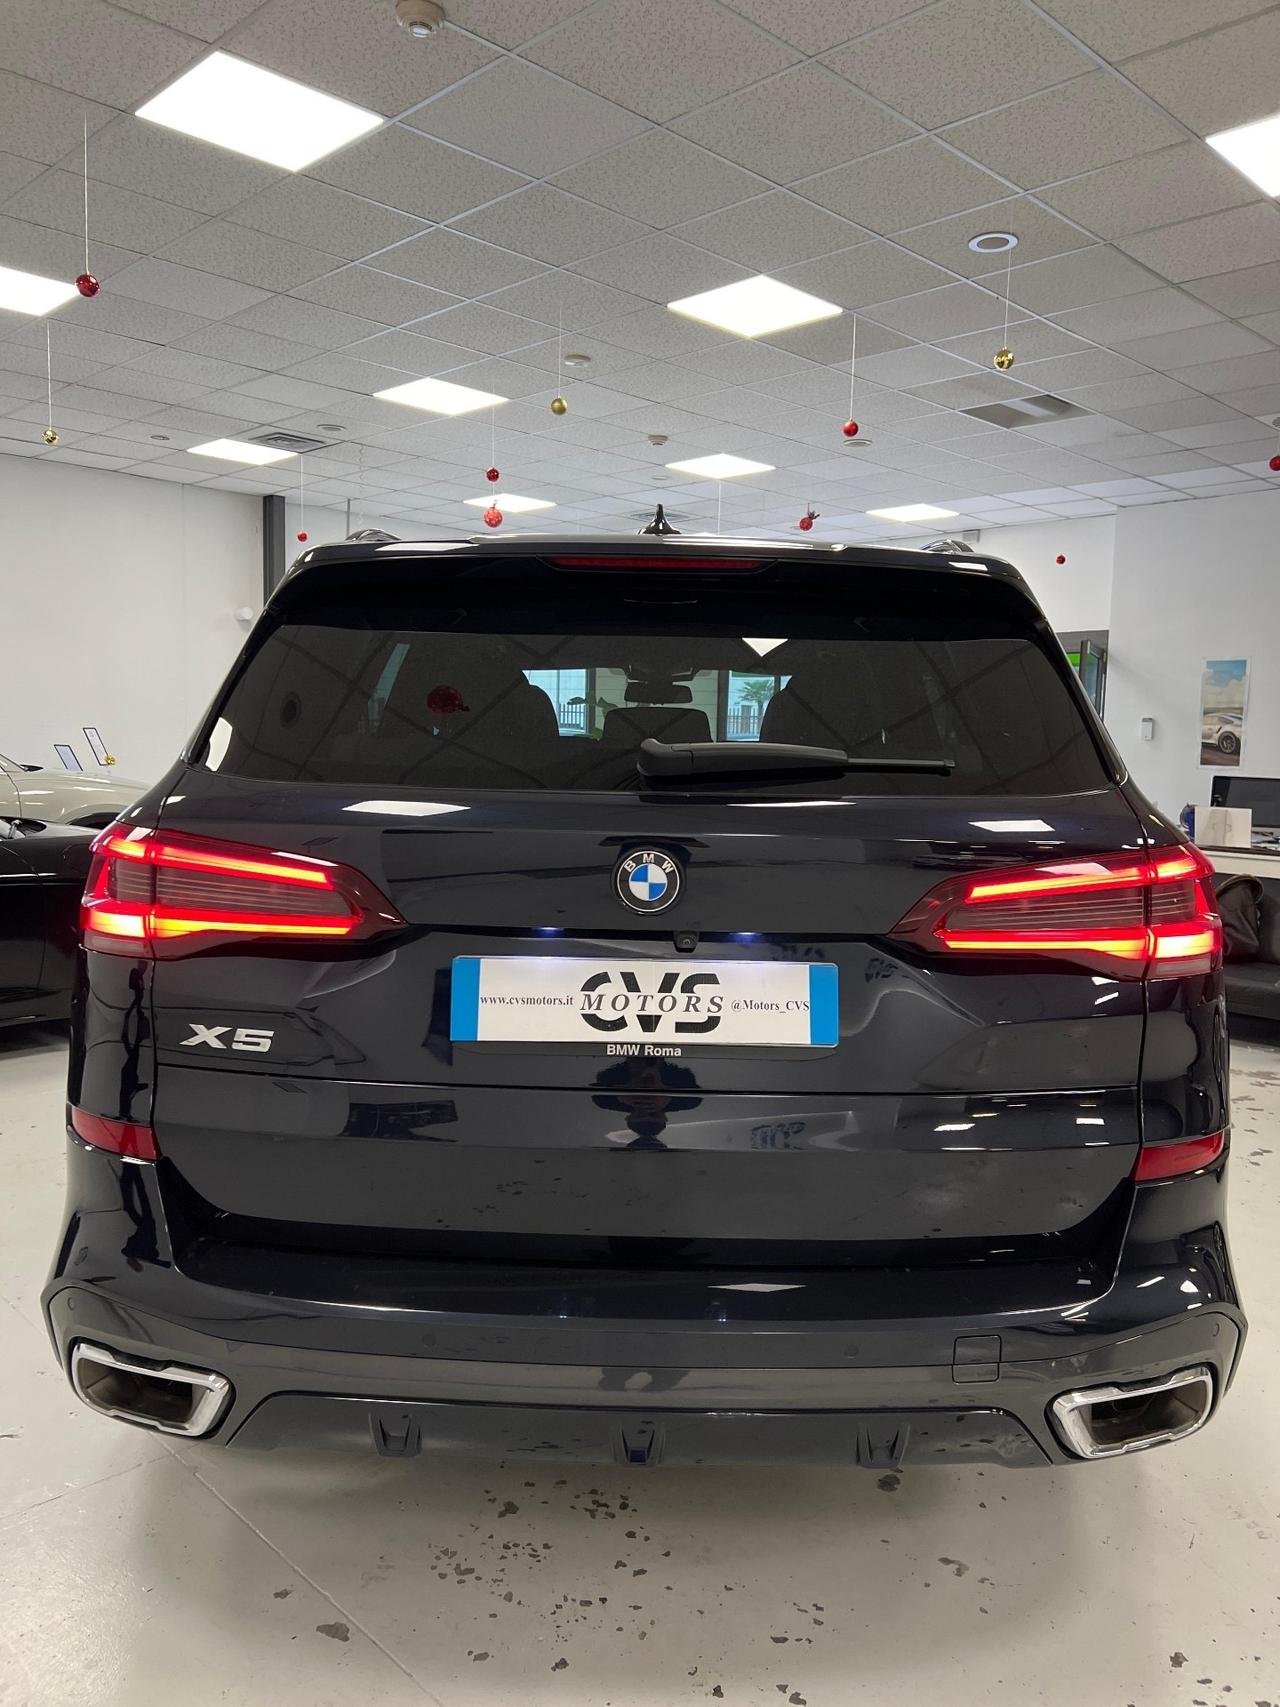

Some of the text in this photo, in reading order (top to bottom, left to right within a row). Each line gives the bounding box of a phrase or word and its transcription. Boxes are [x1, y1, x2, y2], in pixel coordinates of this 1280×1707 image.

[623, 853, 674, 873] BMW
[480, 995, 574, 1006] www.cvsmotors.it
[580, 971, 721, 1033] CVS
[580, 994, 724, 1013] MOTORS
[731, 1000, 810, 1013] @Motors_CVS
[179, 1023, 275, 1053] X5
[606, 1044, 682, 1057] BMW Roma
